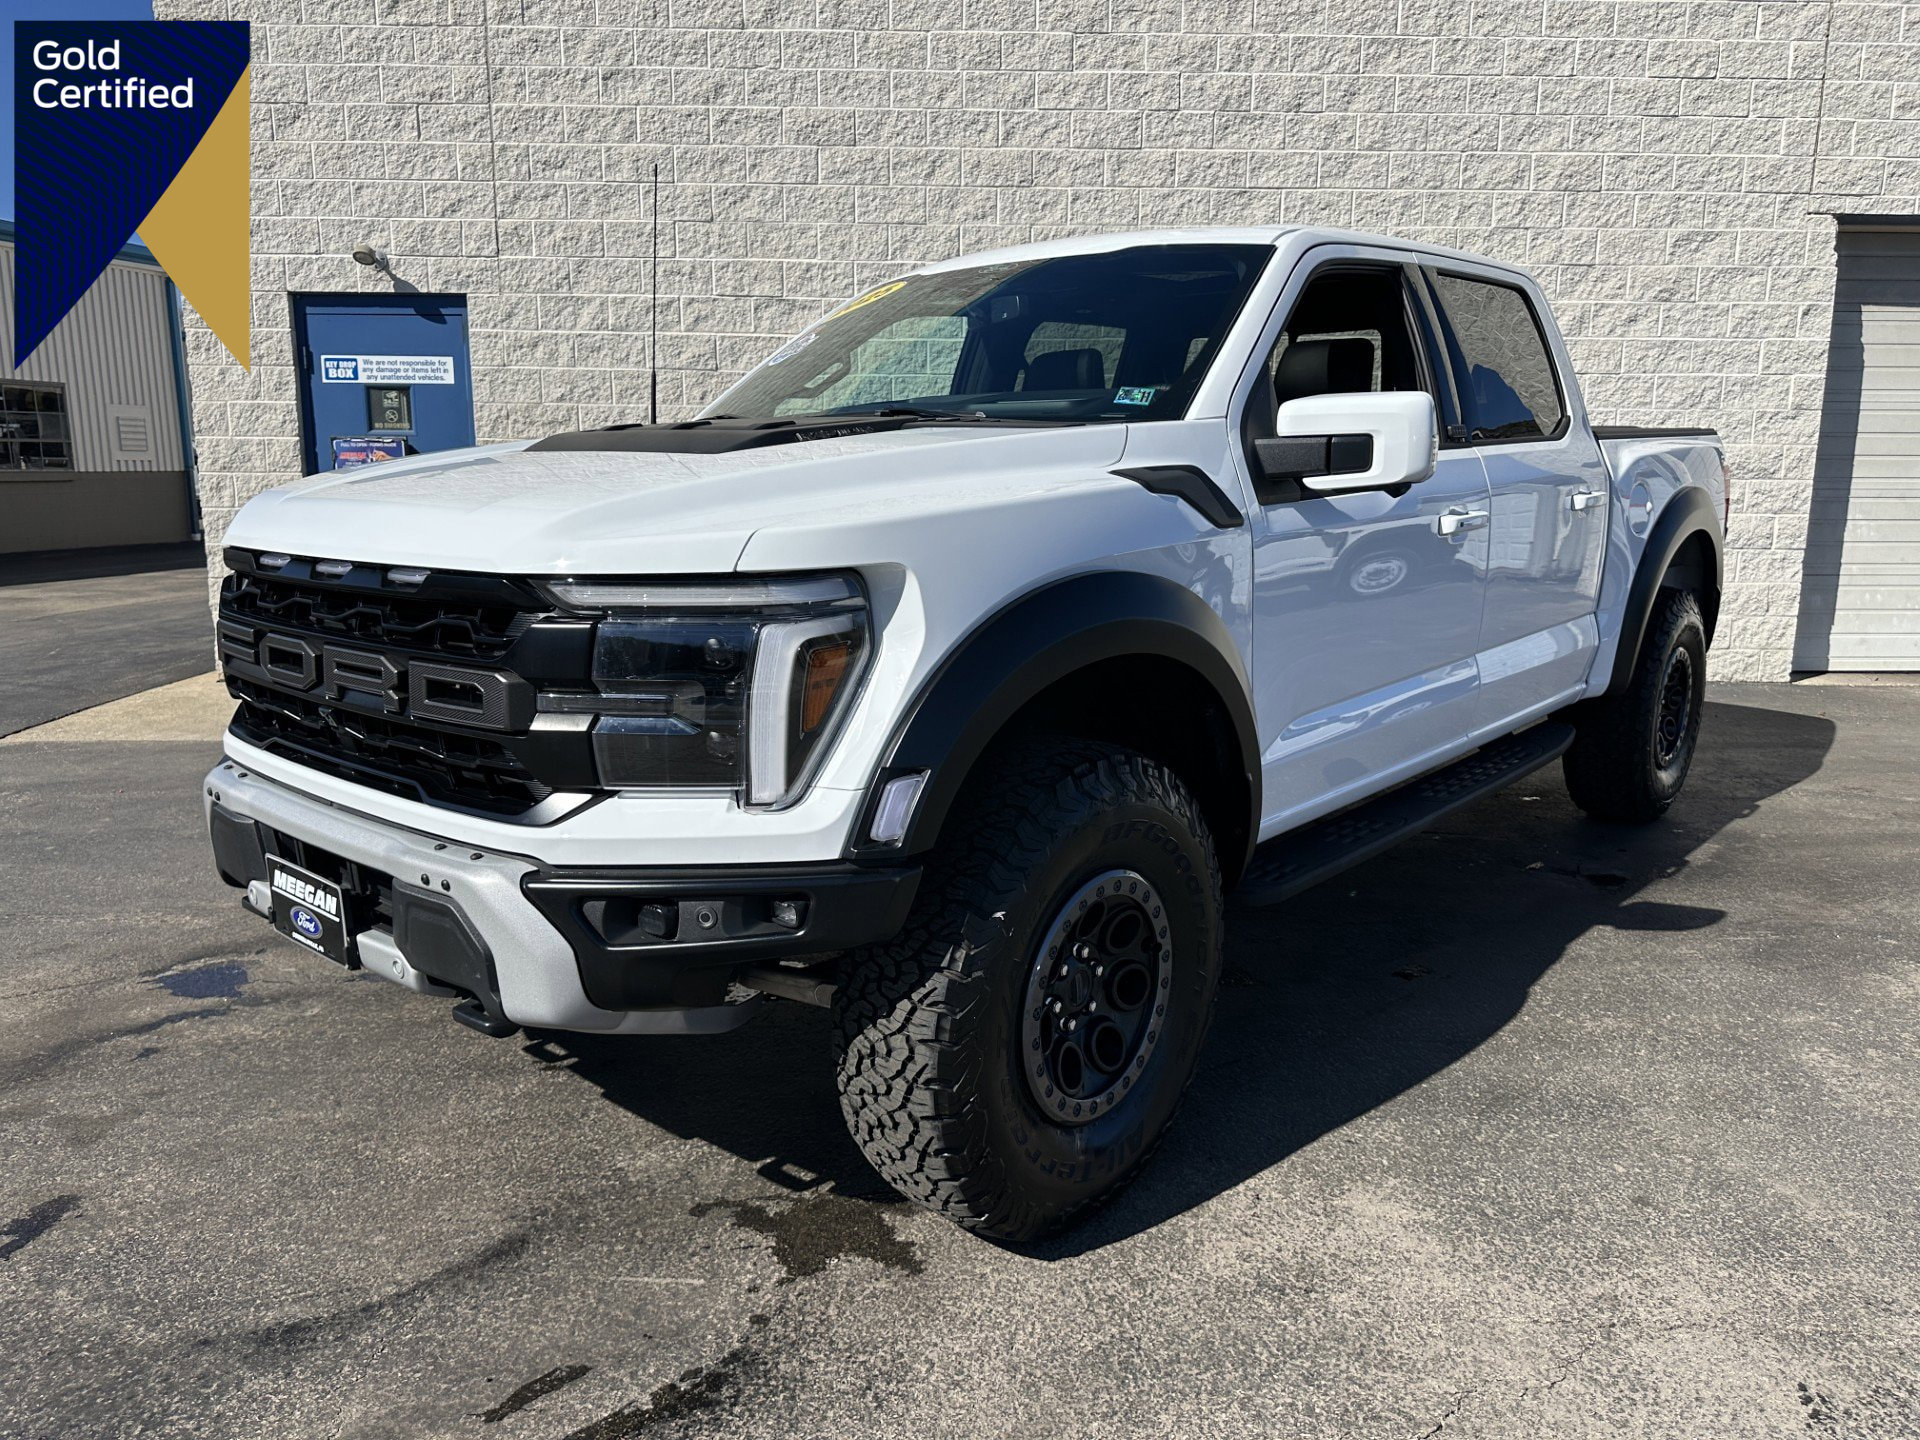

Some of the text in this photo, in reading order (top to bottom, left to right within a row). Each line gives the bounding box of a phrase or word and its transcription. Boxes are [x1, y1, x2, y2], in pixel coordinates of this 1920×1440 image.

[325, 360, 356, 368] KEY DROP
[328, 368, 354, 378] BOX
[218, 620, 532, 732] FORD
[273, 868, 338, 915] MEEGAN
[297, 911, 315, 933] Ford
